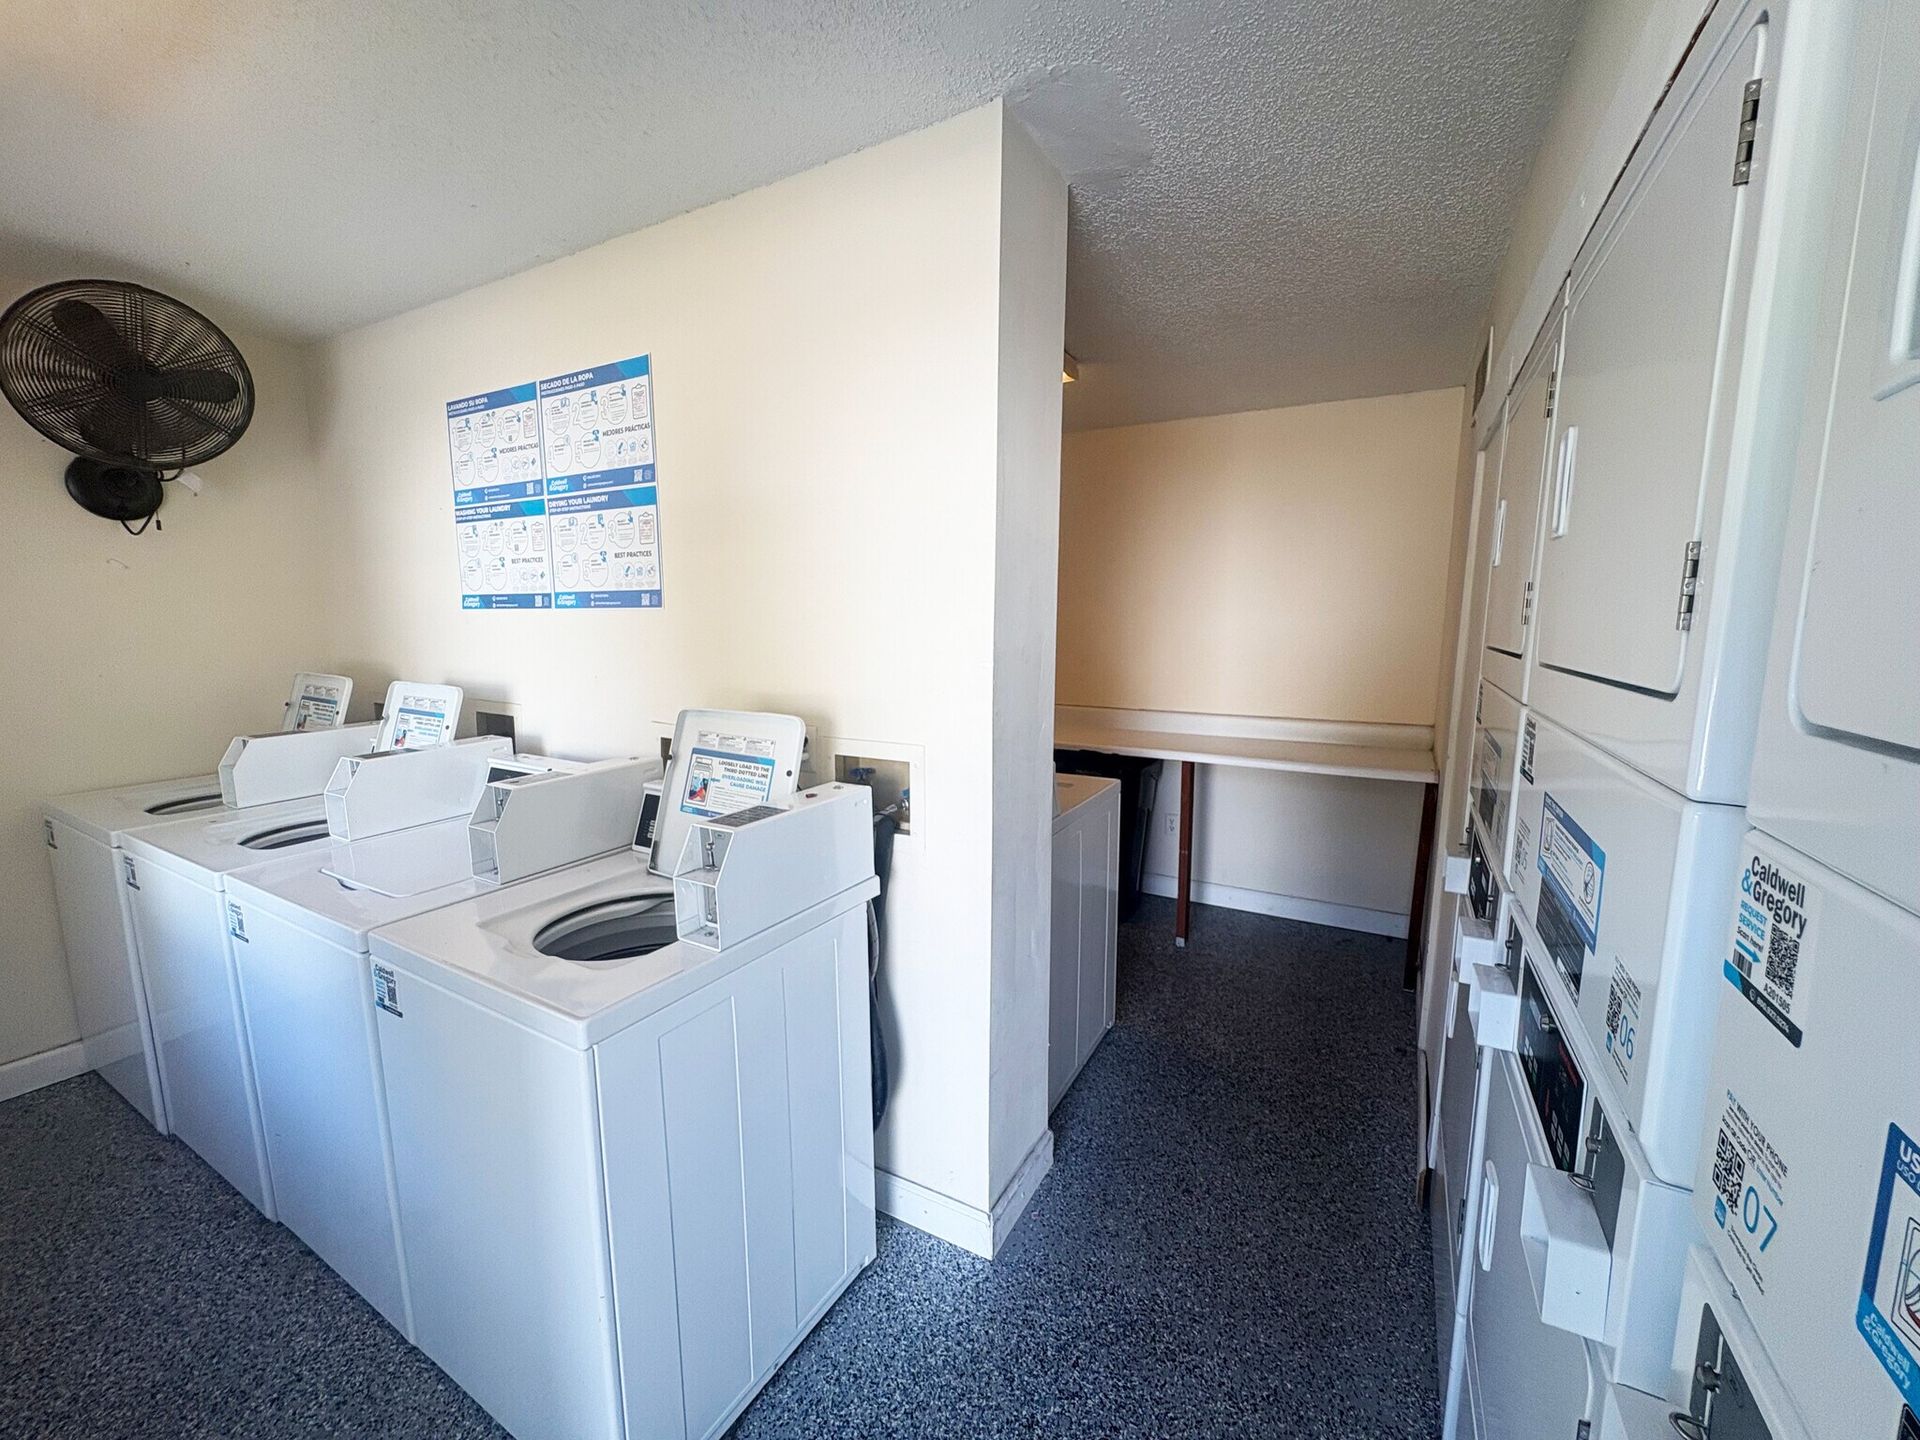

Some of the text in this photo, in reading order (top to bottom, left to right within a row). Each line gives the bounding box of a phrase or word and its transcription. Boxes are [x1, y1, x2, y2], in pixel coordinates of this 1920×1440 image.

[476, 506, 489, 514] YOUR
[549, 494, 609, 508] DRYING YOUR LAUNDRY
[614, 550, 652, 559] BEST PRACTICES
[718, 760, 739, 768] LOOSELY
[738, 762, 753, 770] LOAD
[738, 768, 758, 777] DOTTED
[729, 781, 767, 792] CAUSE DAMAGE
[1751, 855, 1806, 909] Caldwell
[1741, 899, 1768, 926] REQUEST
[1739, 912, 1766, 941] SERVICE
[1620, 1014, 1635, 1061] 06
[1750, 1119, 1767, 1147] YOUR
[1765, 1141, 1788, 1179] PHONE
[1896, 1159, 1917, 1184] USO
[1743, 1185, 1778, 1252] 07
